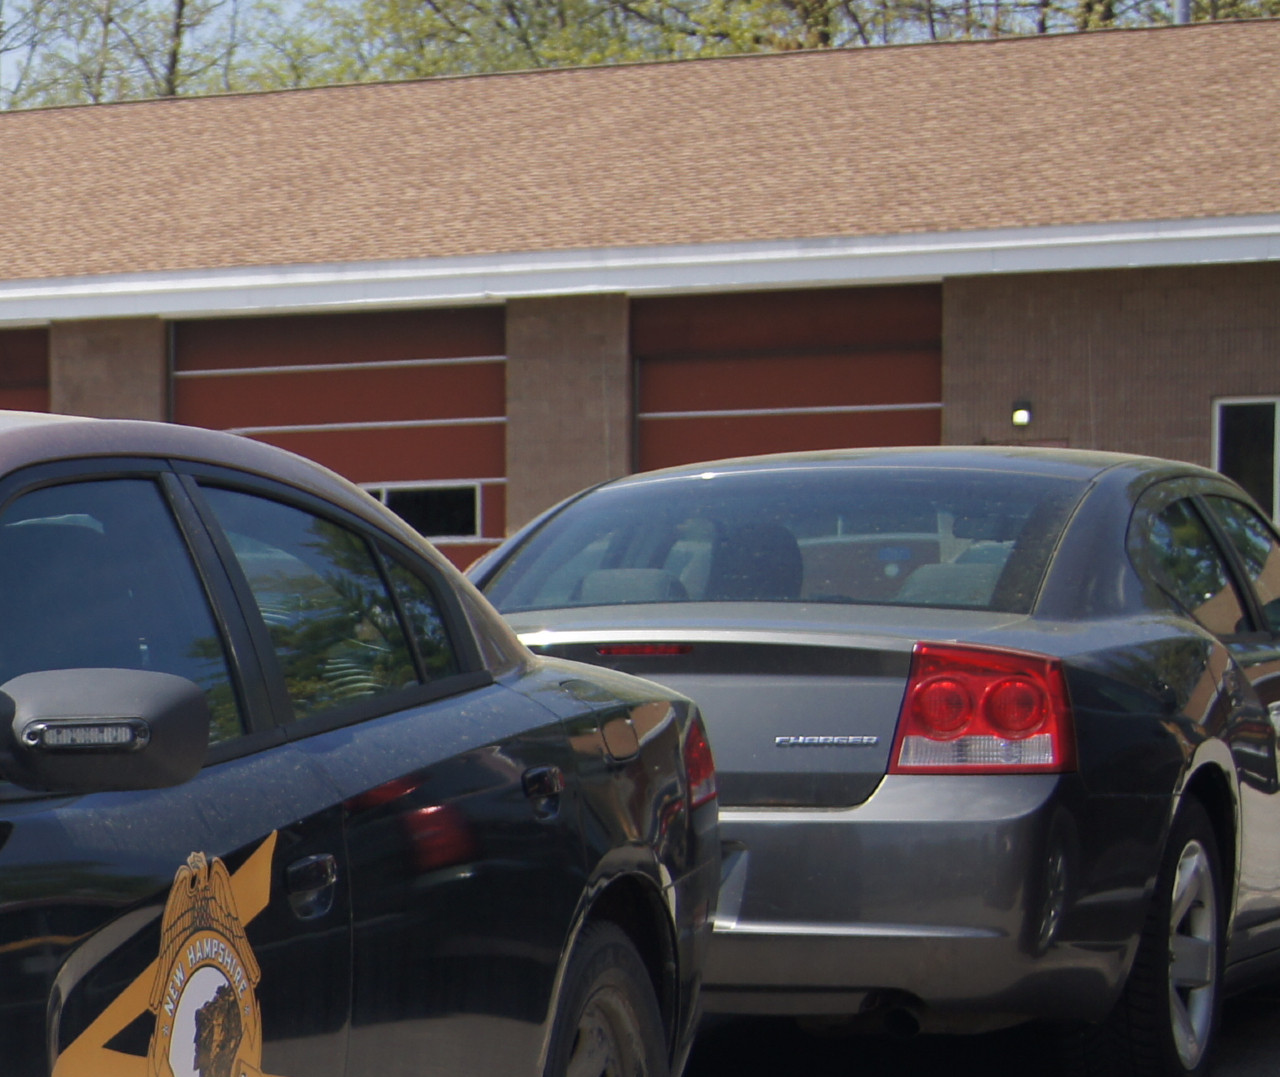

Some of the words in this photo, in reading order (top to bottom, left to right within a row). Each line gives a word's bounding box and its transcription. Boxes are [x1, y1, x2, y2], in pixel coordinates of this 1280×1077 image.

[775, 736, 878, 745] CHARGER
[164, 961, 185, 1017] NEW
[187, 938, 248, 999] HAMPSHIRE
